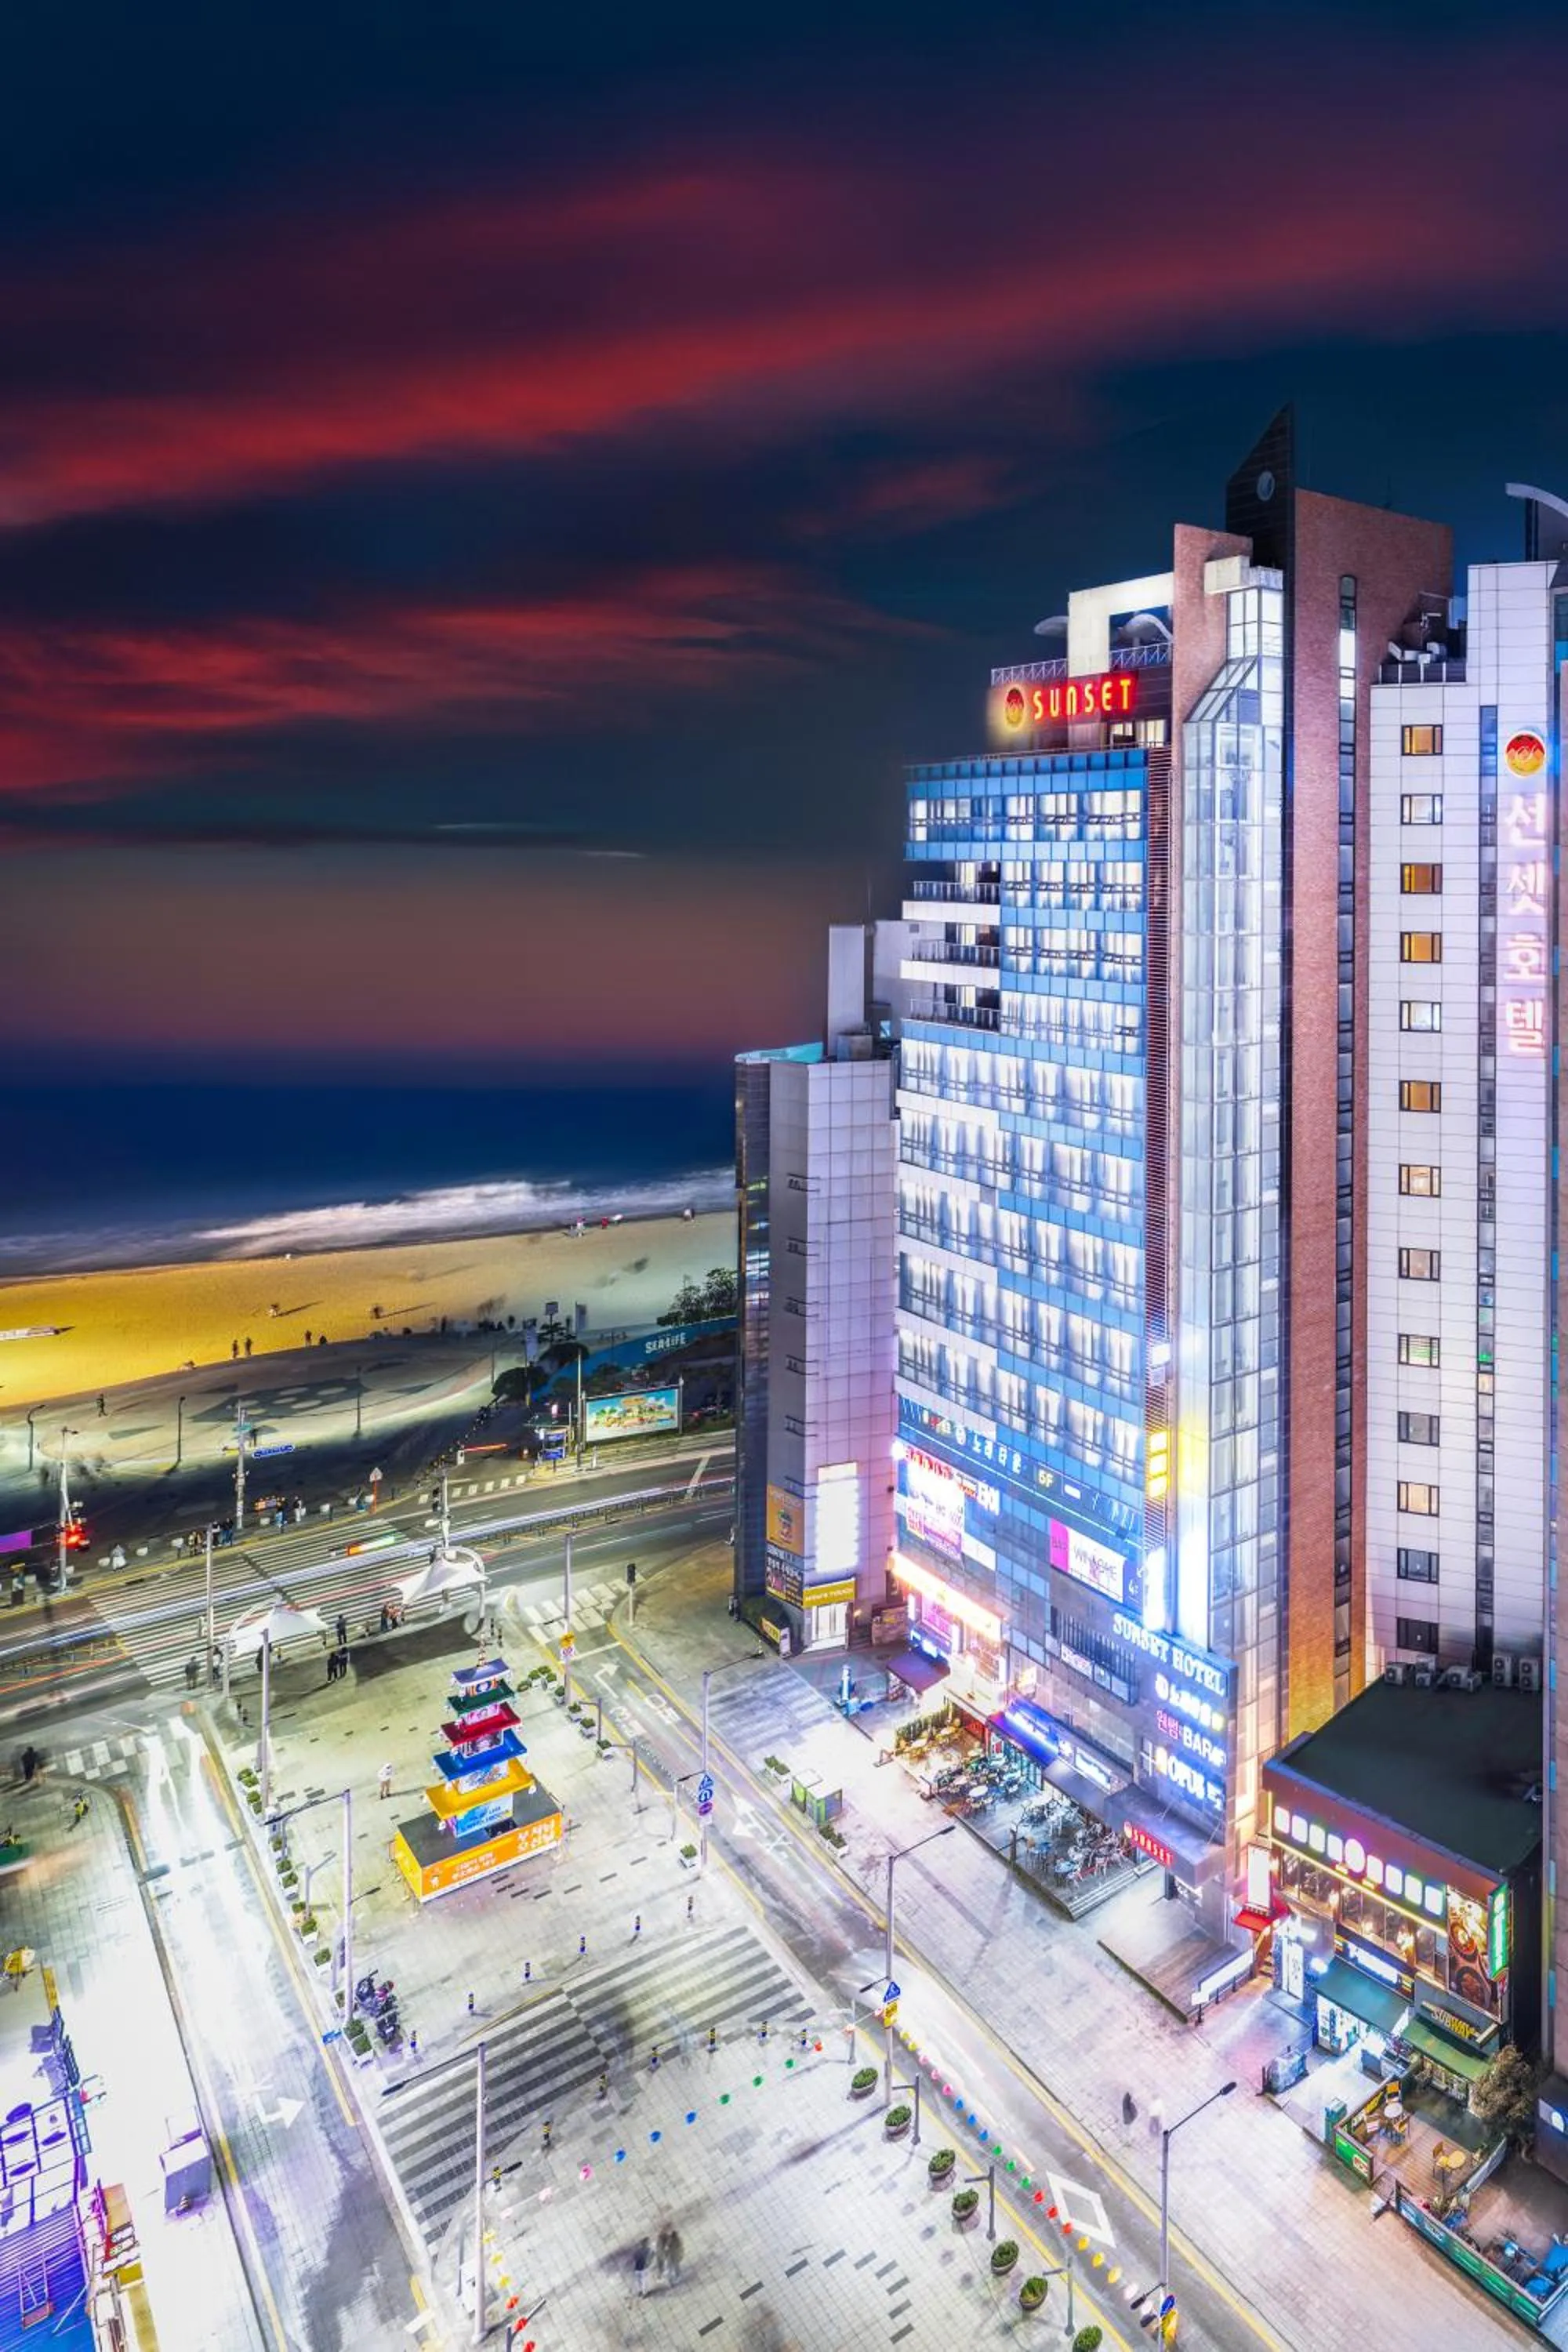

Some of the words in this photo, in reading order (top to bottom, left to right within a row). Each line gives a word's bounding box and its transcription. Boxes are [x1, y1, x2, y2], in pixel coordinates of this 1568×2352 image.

[1033, 679, 1131, 720] SUNSET
[1112, 1613, 1170, 1663] SUNSET
[1172, 1646, 1225, 1698] HOTEL
[1432, 2007, 1475, 2038] SUBWAY
